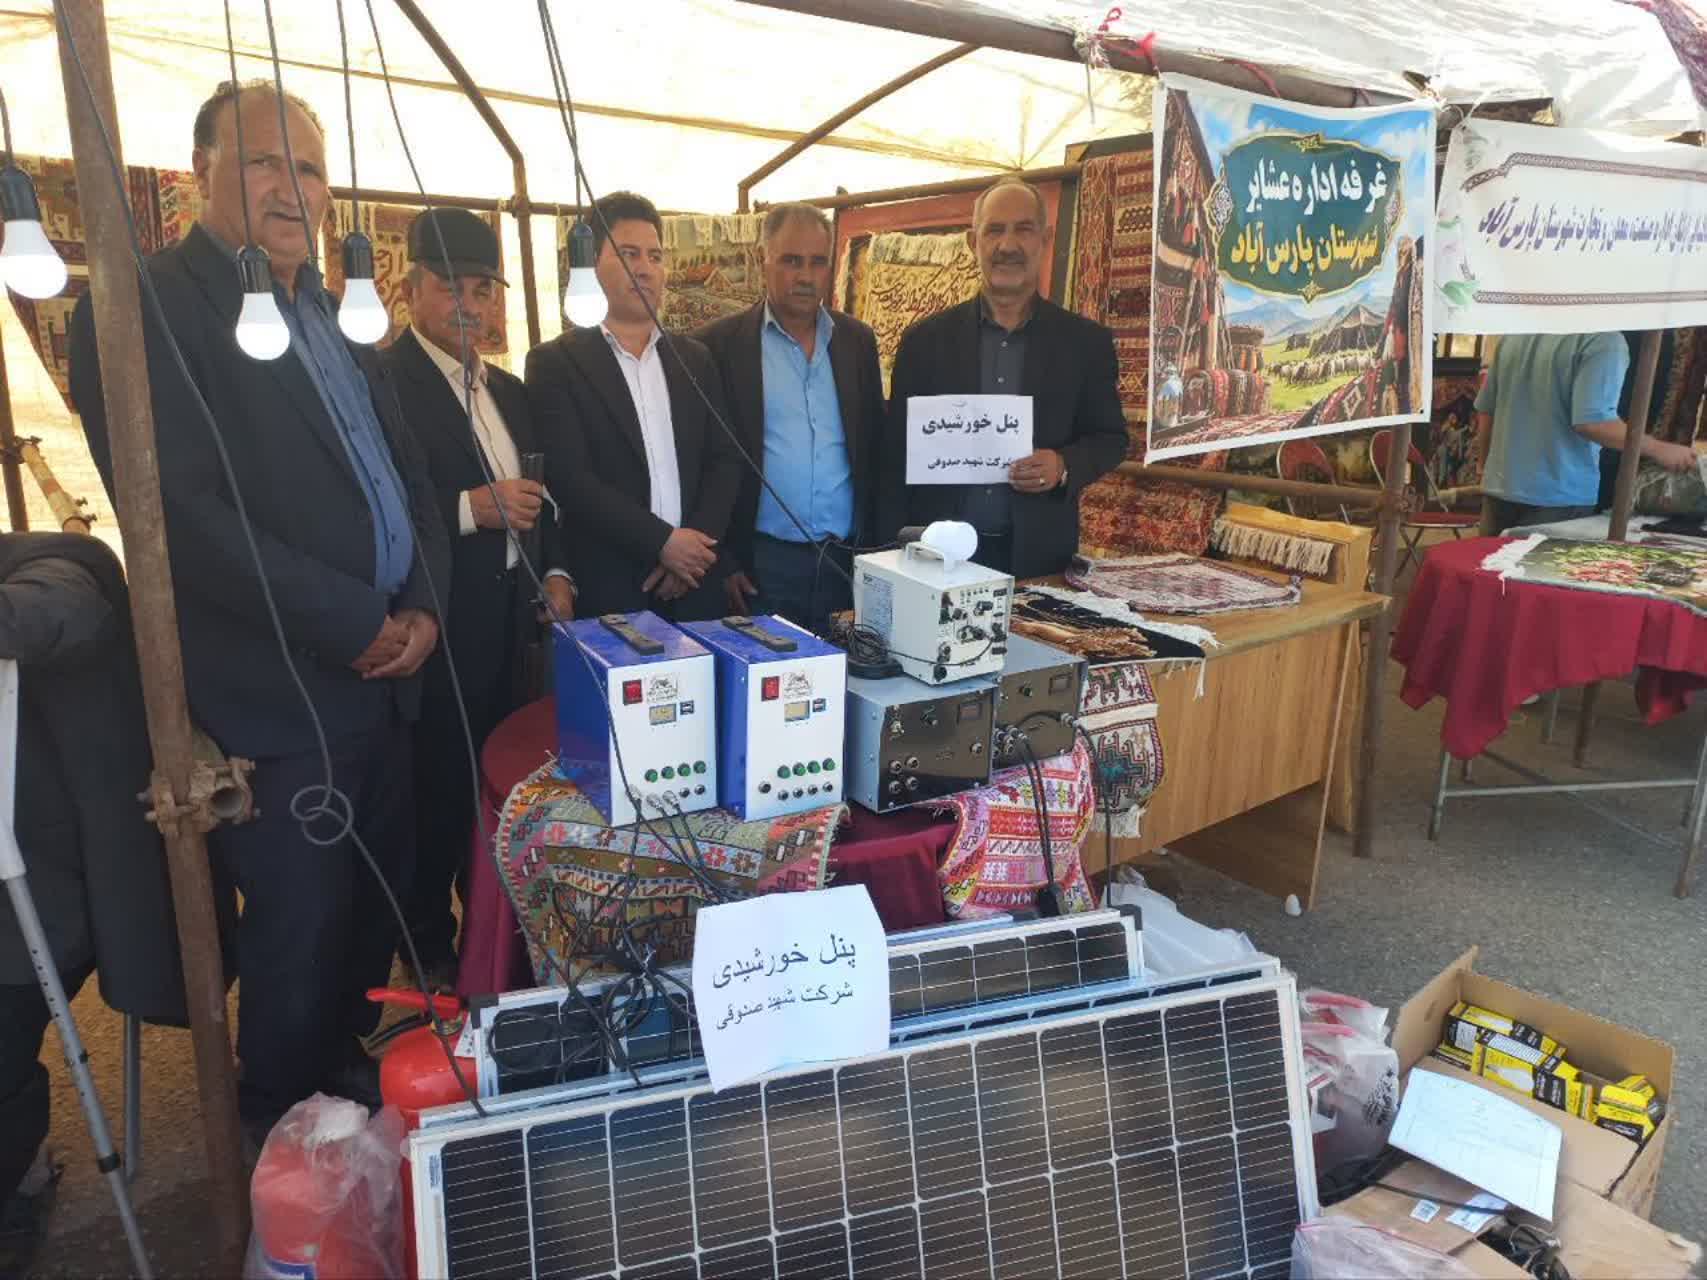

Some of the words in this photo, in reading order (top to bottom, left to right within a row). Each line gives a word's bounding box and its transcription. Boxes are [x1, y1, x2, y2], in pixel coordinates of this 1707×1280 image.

[1246, 158, 1291, 213] عشایر
[1293, 158, 1337, 215] اداره
[1340, 158, 1388, 213] غرفه
[1477, 196, 1520, 243] آباد
[1499, 202, 1539, 251] پارس
[1230, 221, 1266, 274] آباد
[1266, 223, 1314, 274] پارس
[1317, 223, 1378, 271] شهرستان
[922, 413, 991, 434] خورشیدی
[996, 413, 1019, 434] پنل
[712, 942, 809, 989] خورشیدی
[819, 933, 856, 968] پنل
[800, 982, 854, 1005] شرکت
